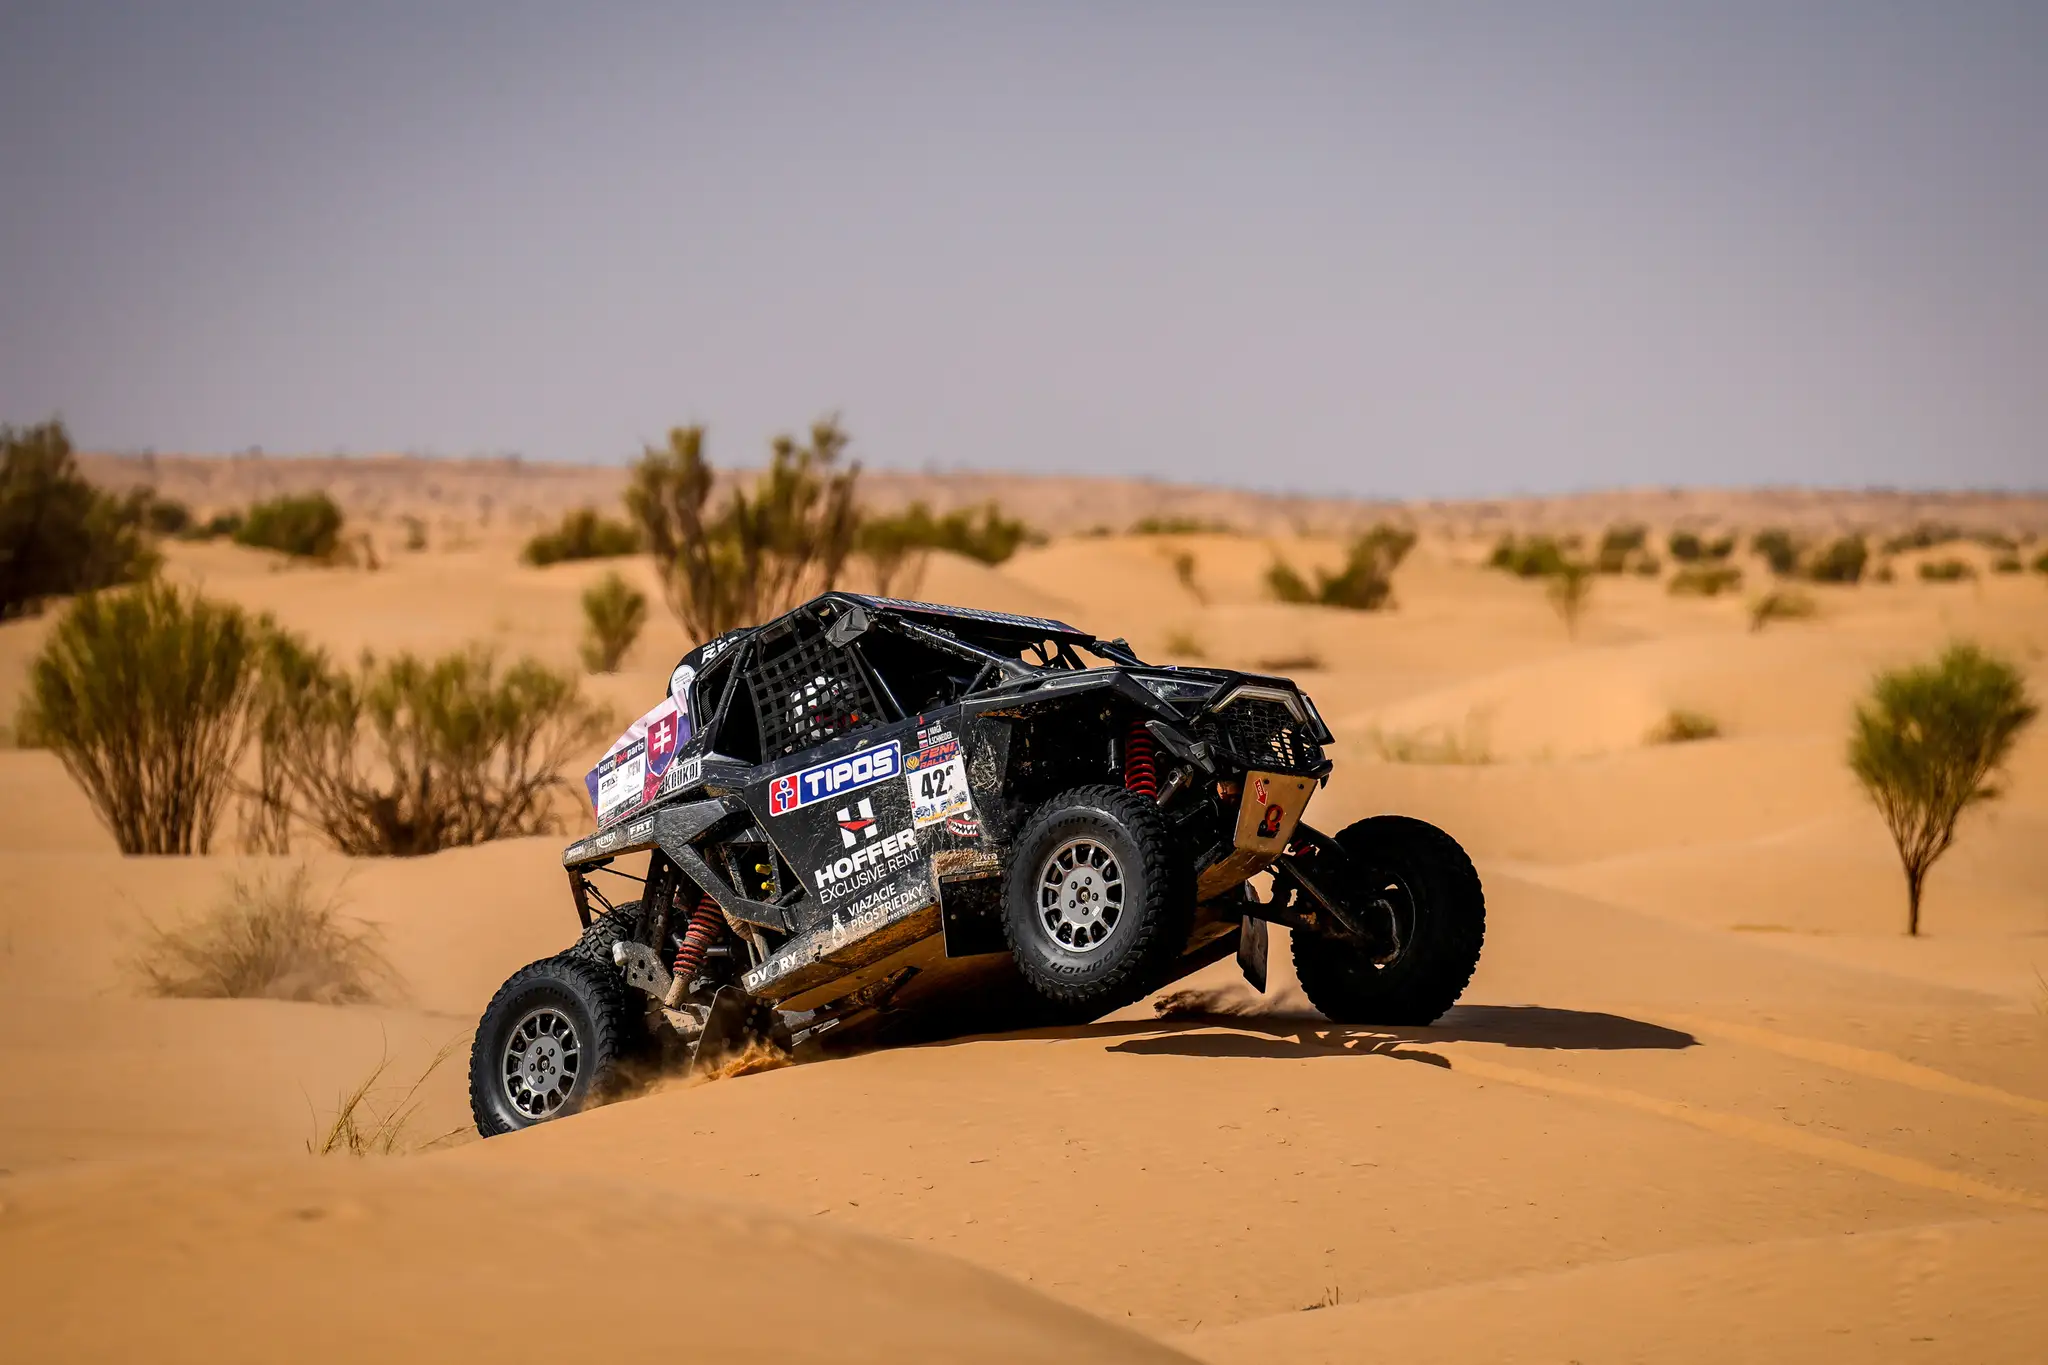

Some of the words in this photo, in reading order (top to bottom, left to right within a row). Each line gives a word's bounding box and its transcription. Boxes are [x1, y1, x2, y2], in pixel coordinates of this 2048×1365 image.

[805, 749, 892, 797] TIPOS
[920, 754, 951, 769] RALLY
[596, 831, 618, 847] RENEX
[629, 820, 652, 835] FRT
[814, 828, 916, 888] HOFFER
[819, 866, 887, 904] EXCLUSIVE
[886, 847, 921, 874] RENT
[847, 882, 896, 917] VIAZACIE
[850, 884, 924, 931] PROSTRIEDKY
